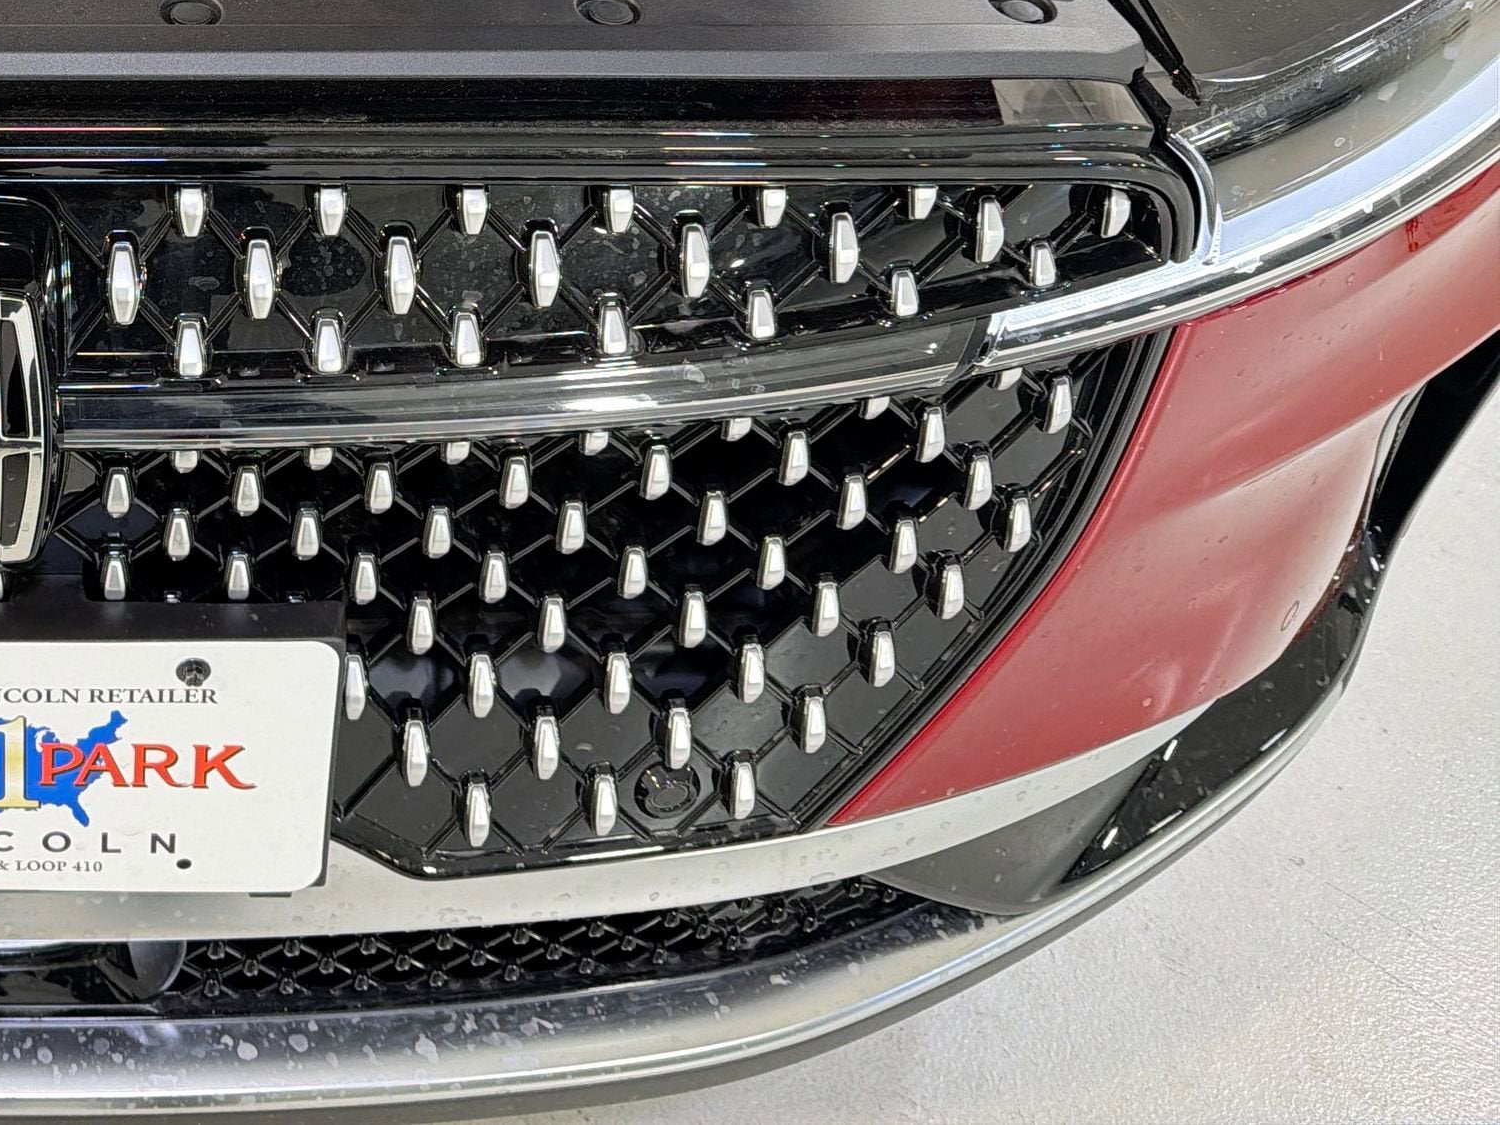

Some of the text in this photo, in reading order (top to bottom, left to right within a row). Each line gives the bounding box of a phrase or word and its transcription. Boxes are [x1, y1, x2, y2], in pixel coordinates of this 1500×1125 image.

[87, 688, 219, 705] RETAILER
[39, 742, 258, 790] PARK
[15, 860, 67, 872] LOOP
[71, 859, 103, 873] 410
